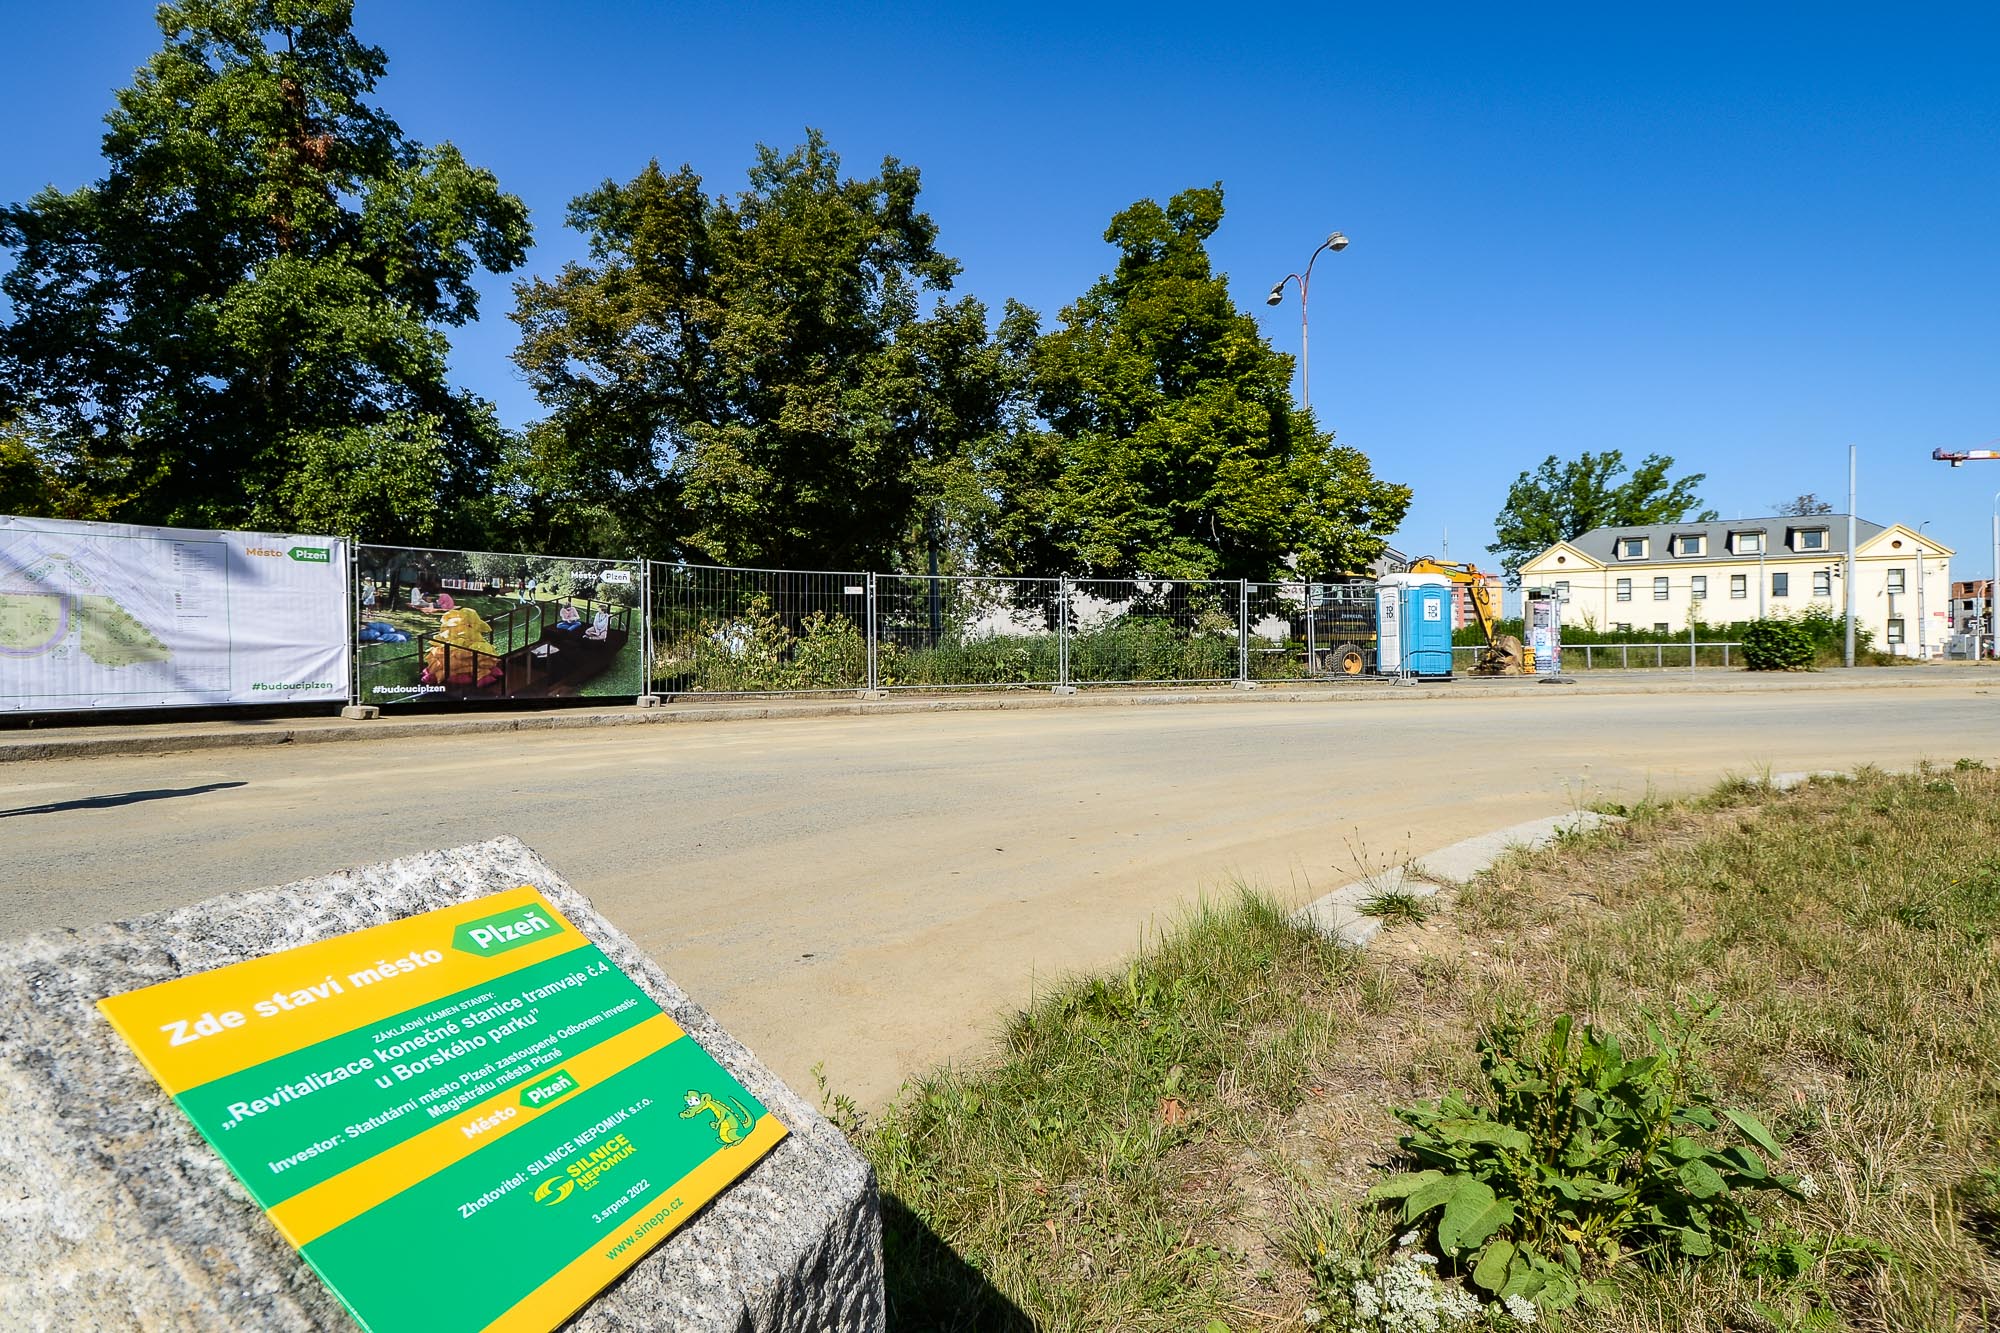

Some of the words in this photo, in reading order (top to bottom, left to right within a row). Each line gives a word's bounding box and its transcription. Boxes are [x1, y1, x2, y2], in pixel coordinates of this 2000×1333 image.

[246, 547, 283, 557] Město
[295, 549, 327, 560] Plzeň
[571, 570, 597, 579] Město
[606, 572, 628, 581] Plzeň
[252, 681, 333, 690] #budouciplzen
[372, 684, 446, 694] #budouciplzen
[160, 1011, 247, 1047] Zde
[254, 976, 344, 1017] staví
[348, 949, 443, 988] město
[468, 912, 550, 949] Plzeň
[222, 1057, 374, 1130] „Revitalizace
[373, 1020, 460, 1063] konečné
[461, 997, 523, 1028] stanice
[522, 971, 588, 1004] tramvaje
[585, 961, 610, 978] č.4
[372, 1016, 427, 1043] ZÁKLADNÍ
[424, 1005, 459, 1023] KÁMEN
[460, 992, 496, 1010] STAVBY:
[375, 1074, 394, 1089] u
[391, 1035, 487, 1081] Borského
[487, 1008, 539, 1043] parku”
[268, 1134, 346, 1174] Investor:
[345, 1098, 418, 1138] Statutární
[418, 1081, 460, 1106] město
[459, 1063, 496, 1086] Plzeň
[495, 1034, 558, 1069] zastoupené
[557, 1015, 604, 1039] Odborem
[600, 997, 638, 1020] investic
[426, 1082, 496, 1119] Magistrátu
[496, 1064, 533, 1086] města
[532, 1048, 563, 1068] Plzně
[461, 1106, 517, 1138] Město
[527, 1075, 572, 1104] Plzeň
[457, 1172, 529, 1219] Zhotovitel:
[526, 1141, 577, 1177] SILNICE
[573, 1109, 631, 1147] NEPOMUK
[628, 1097, 653, 1115] s.r.o.
[566, 1133, 630, 1178] SILNICE
[575, 1143, 637, 1188] NEPOMUK
[591, 1195, 629, 1224] 3.srpna
[626, 1178, 650, 1198] 2022
[605, 1196, 684, 1261] www.sinepo.cz
